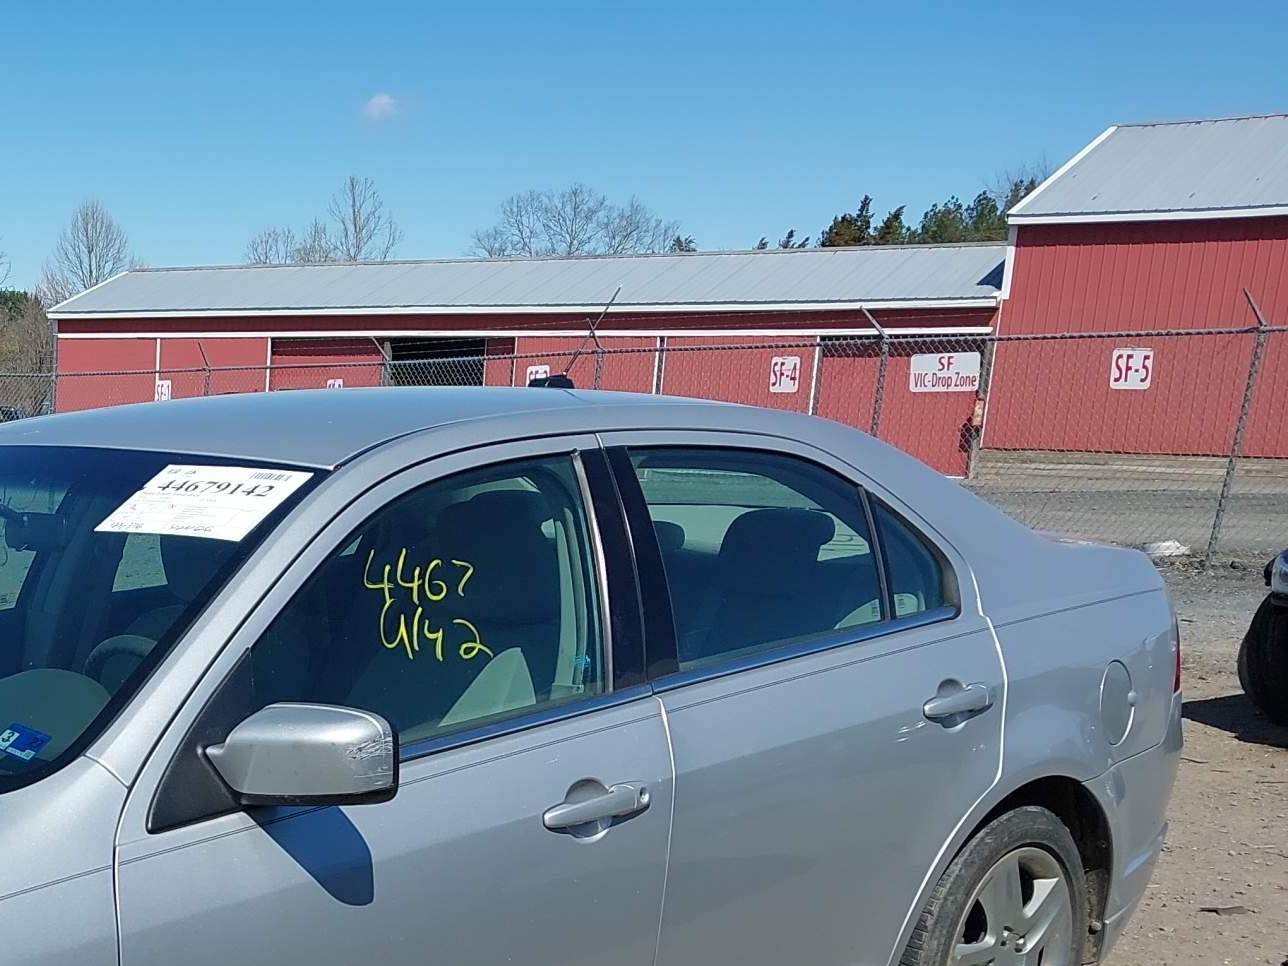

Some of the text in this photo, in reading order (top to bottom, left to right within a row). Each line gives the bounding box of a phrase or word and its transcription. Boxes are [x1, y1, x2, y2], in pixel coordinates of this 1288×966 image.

[938, 356, 954, 371] SF
[1113, 353, 1151, 383] SF-5
[772, 362, 797, 387] SF-4
[913, 372, 977, 389] VIC-Drop Zone
[158, 479, 275, 497] 44679142
[363, 547, 475, 604] 4467
